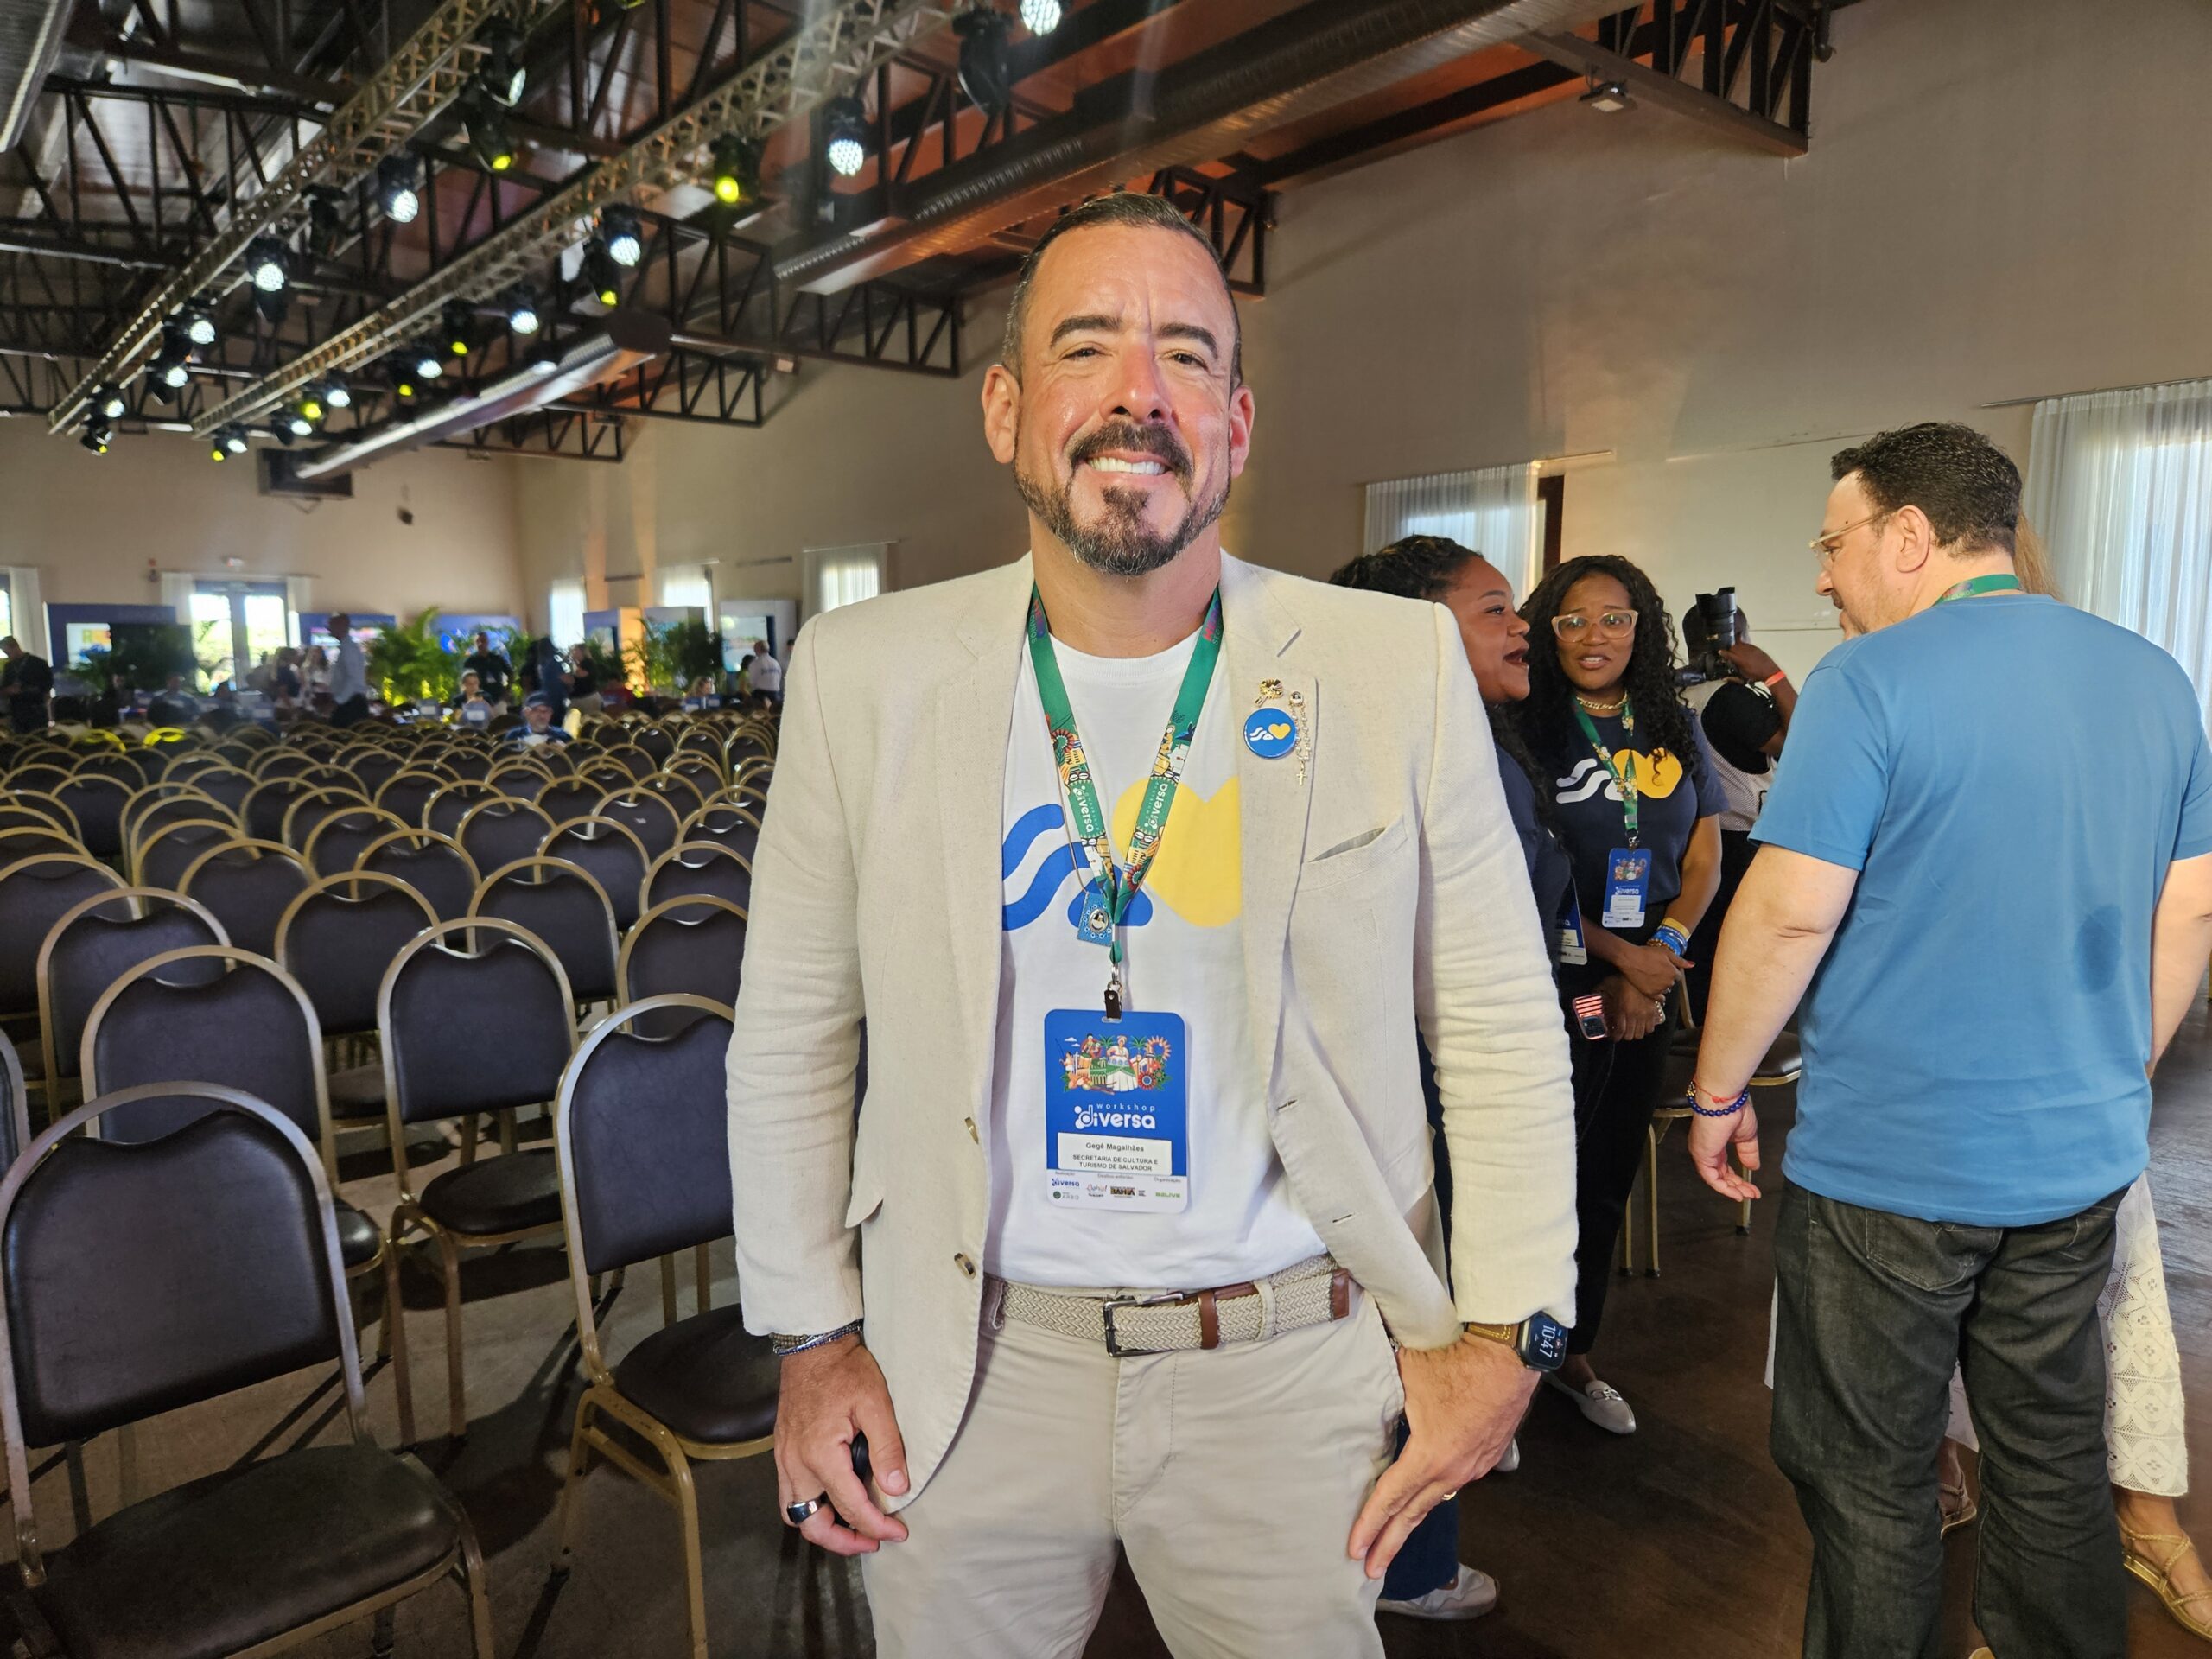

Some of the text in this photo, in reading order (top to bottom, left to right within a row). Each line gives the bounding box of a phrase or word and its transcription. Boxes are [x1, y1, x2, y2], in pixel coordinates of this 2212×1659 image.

[1073, 785, 1094, 832] diversa
[1144, 783, 1168, 830] diversa
[1074, 1105, 1156, 1129] diversa
[1096, 1103, 1155, 1112] workshop
[1106, 1143, 1144, 1152] Magalhães
[1539, 1325, 1556, 1358] 10:47
